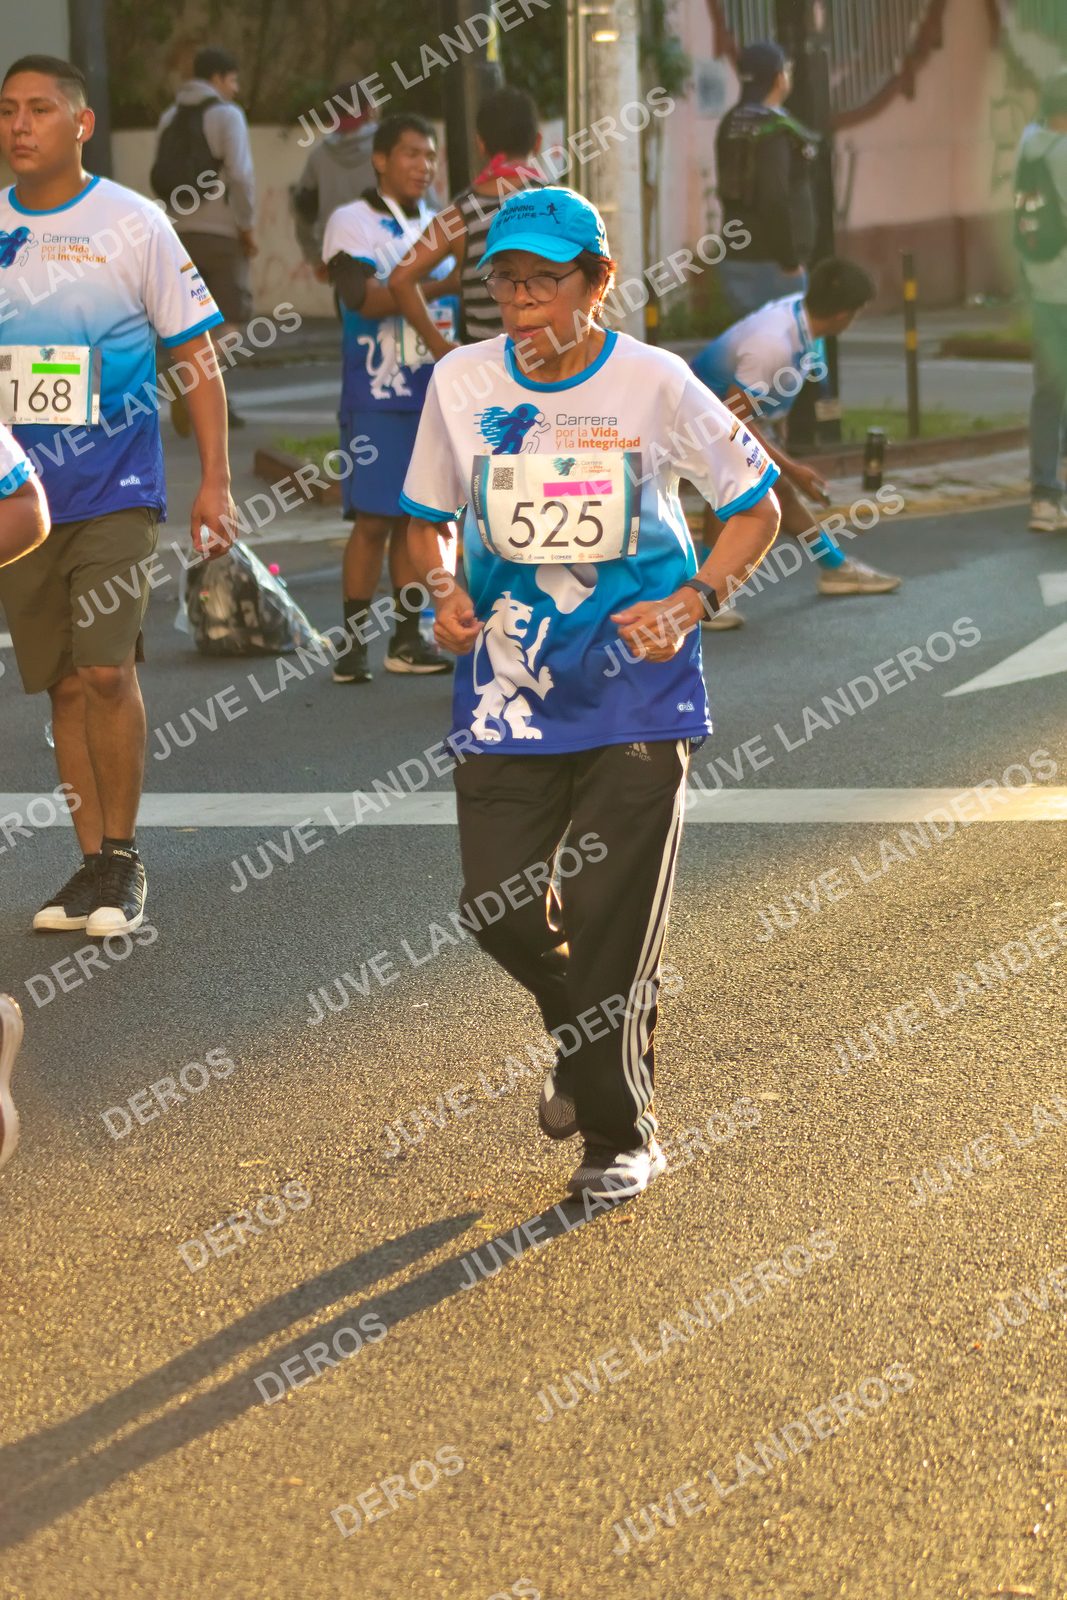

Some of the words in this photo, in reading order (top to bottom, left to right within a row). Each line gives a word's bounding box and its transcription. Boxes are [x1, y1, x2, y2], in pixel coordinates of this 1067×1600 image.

[42, 233, 90, 244] Carrera
[41, 245, 56, 253] por
[68, 245, 89, 253] Vida
[57, 253, 107, 263] Integridad
[10, 378, 72, 413] 168
[555, 413, 618, 426] Carrera
[555, 429, 574, 439] por
[577, 427, 588, 437] la
[591, 427, 619, 437] Vida
[555, 439, 561, 449] y
[564, 438, 575, 448] la
[577, 437, 641, 451] Integridad
[507, 500, 604, 549] 525
[630, 530, 638, 544] 525
